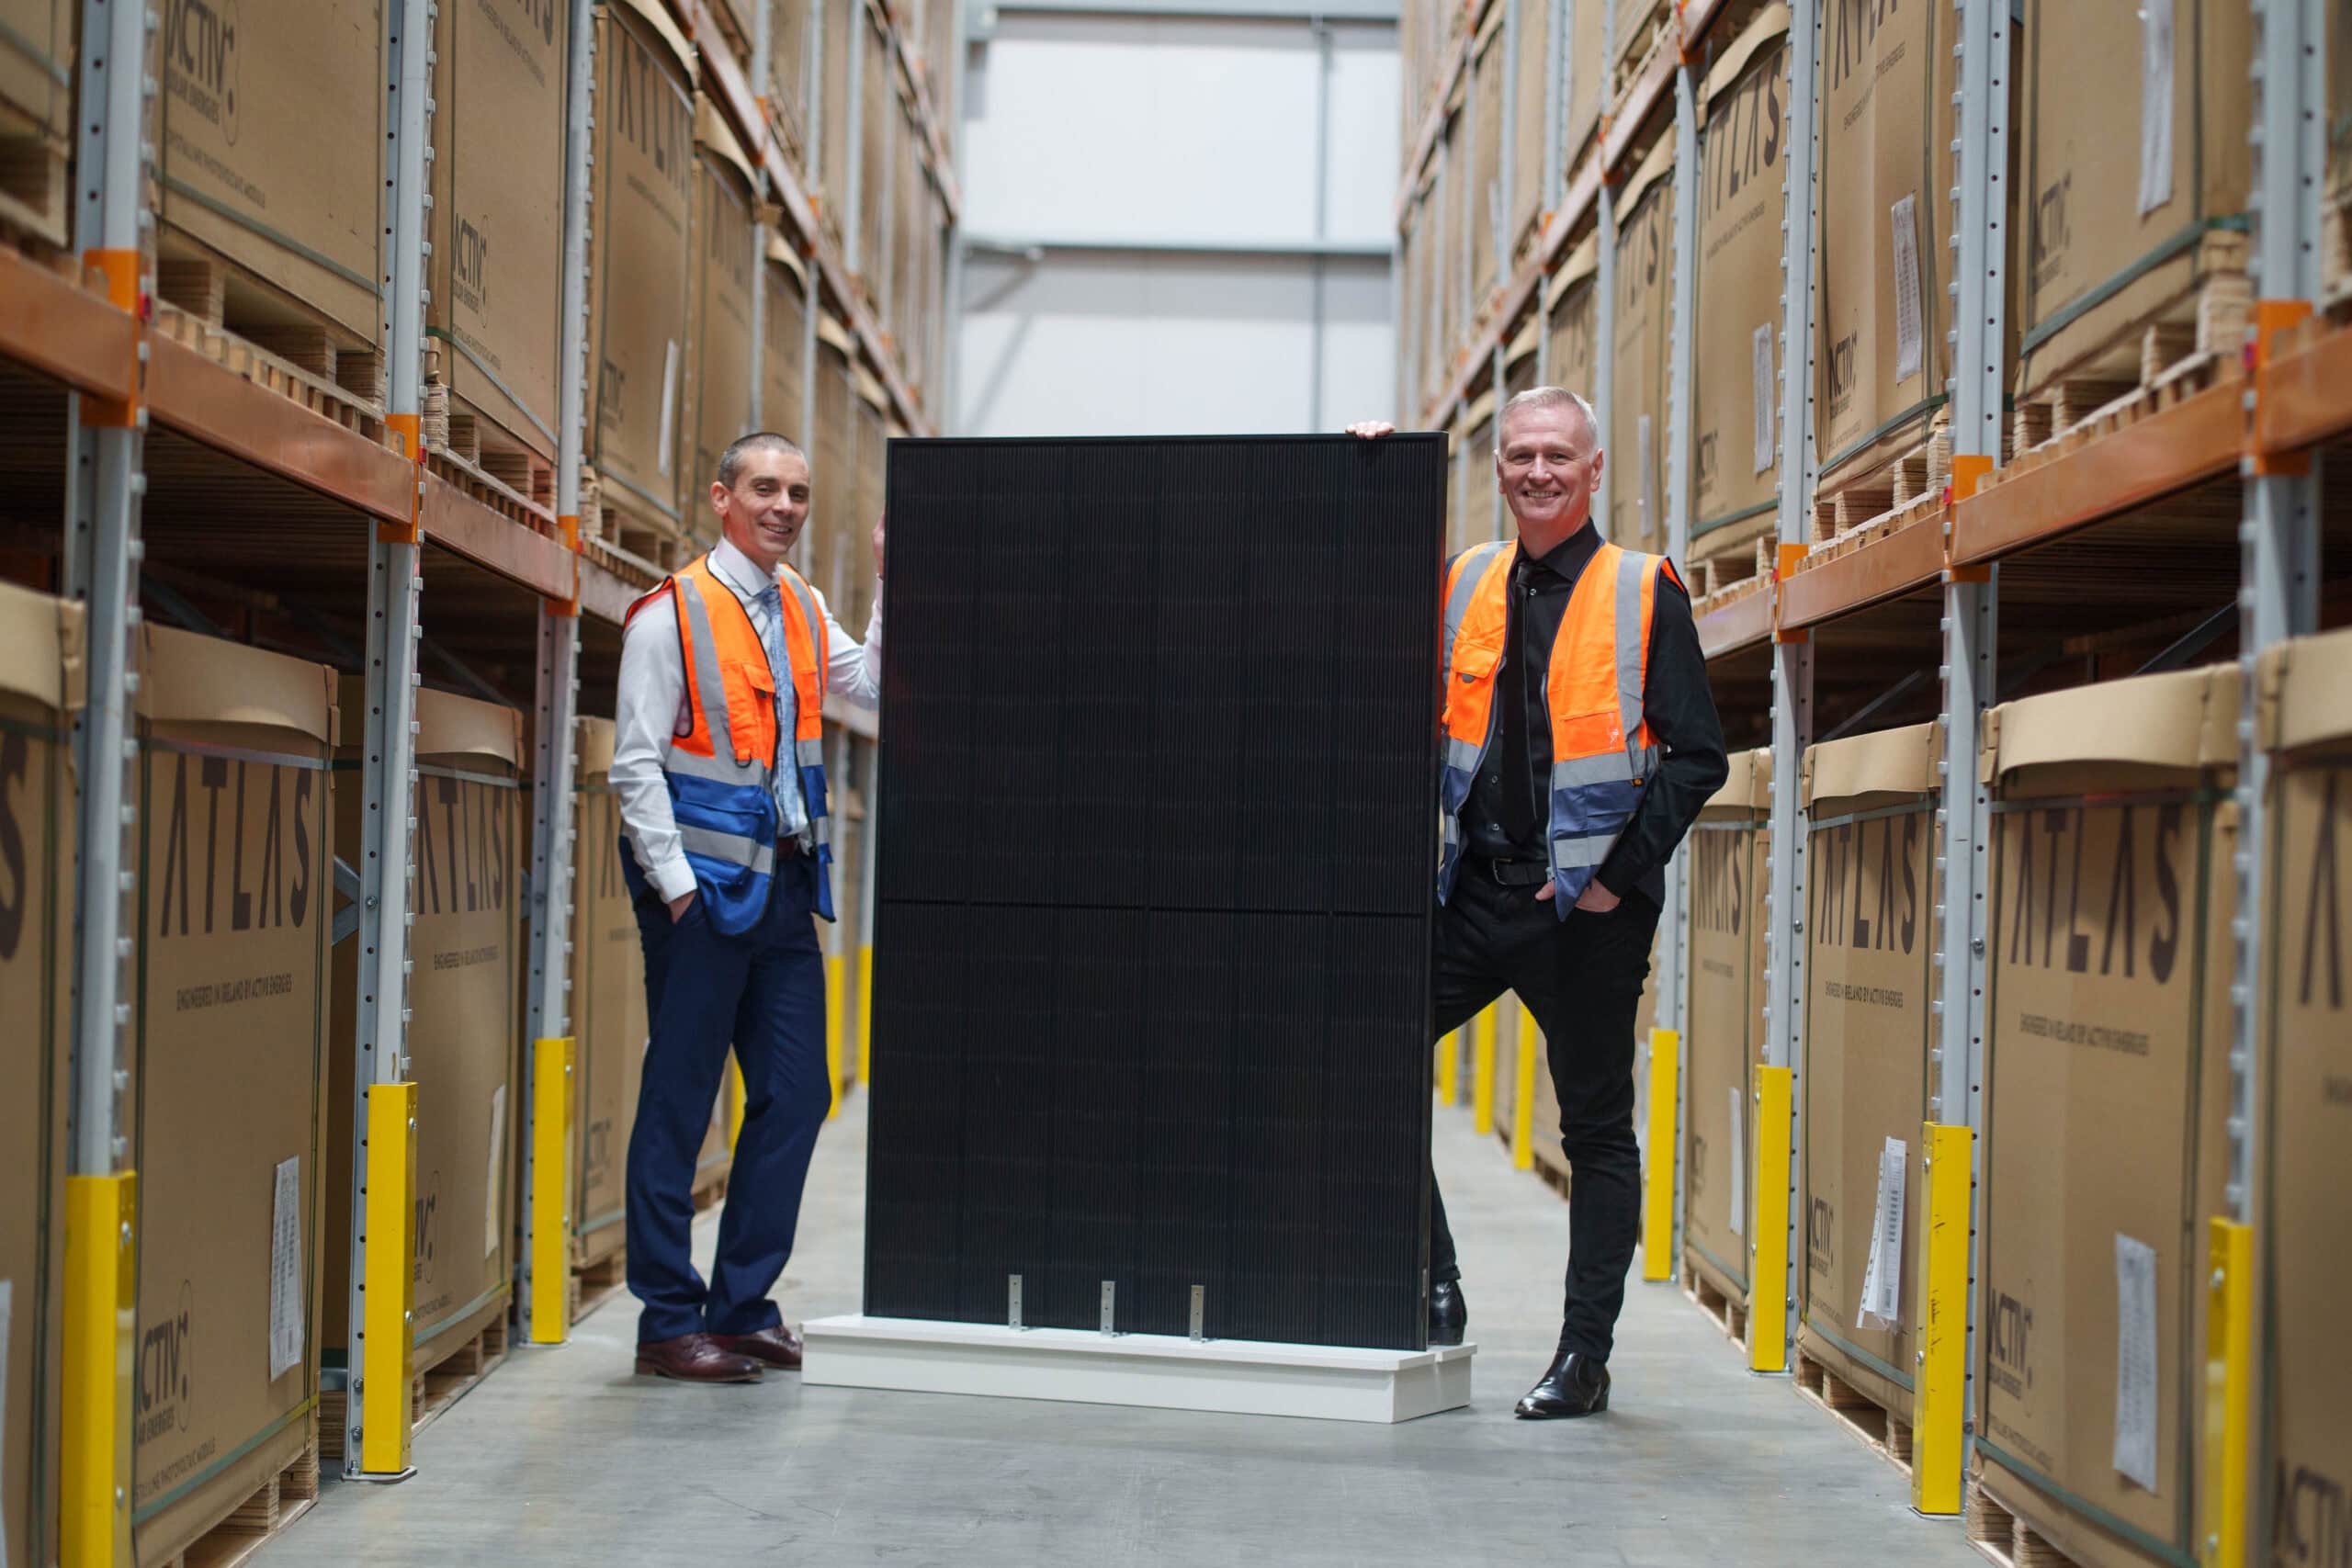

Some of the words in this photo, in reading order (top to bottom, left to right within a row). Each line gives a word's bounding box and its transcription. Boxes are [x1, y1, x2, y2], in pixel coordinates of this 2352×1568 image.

[161, 750, 311, 937] ATLAS
[418, 771, 503, 915] ATLAS
[1819, 811, 1917, 955] ATLAS
[2009, 803, 2182, 985] ATLAS
[141, 1311, 188, 1412] CTIV
